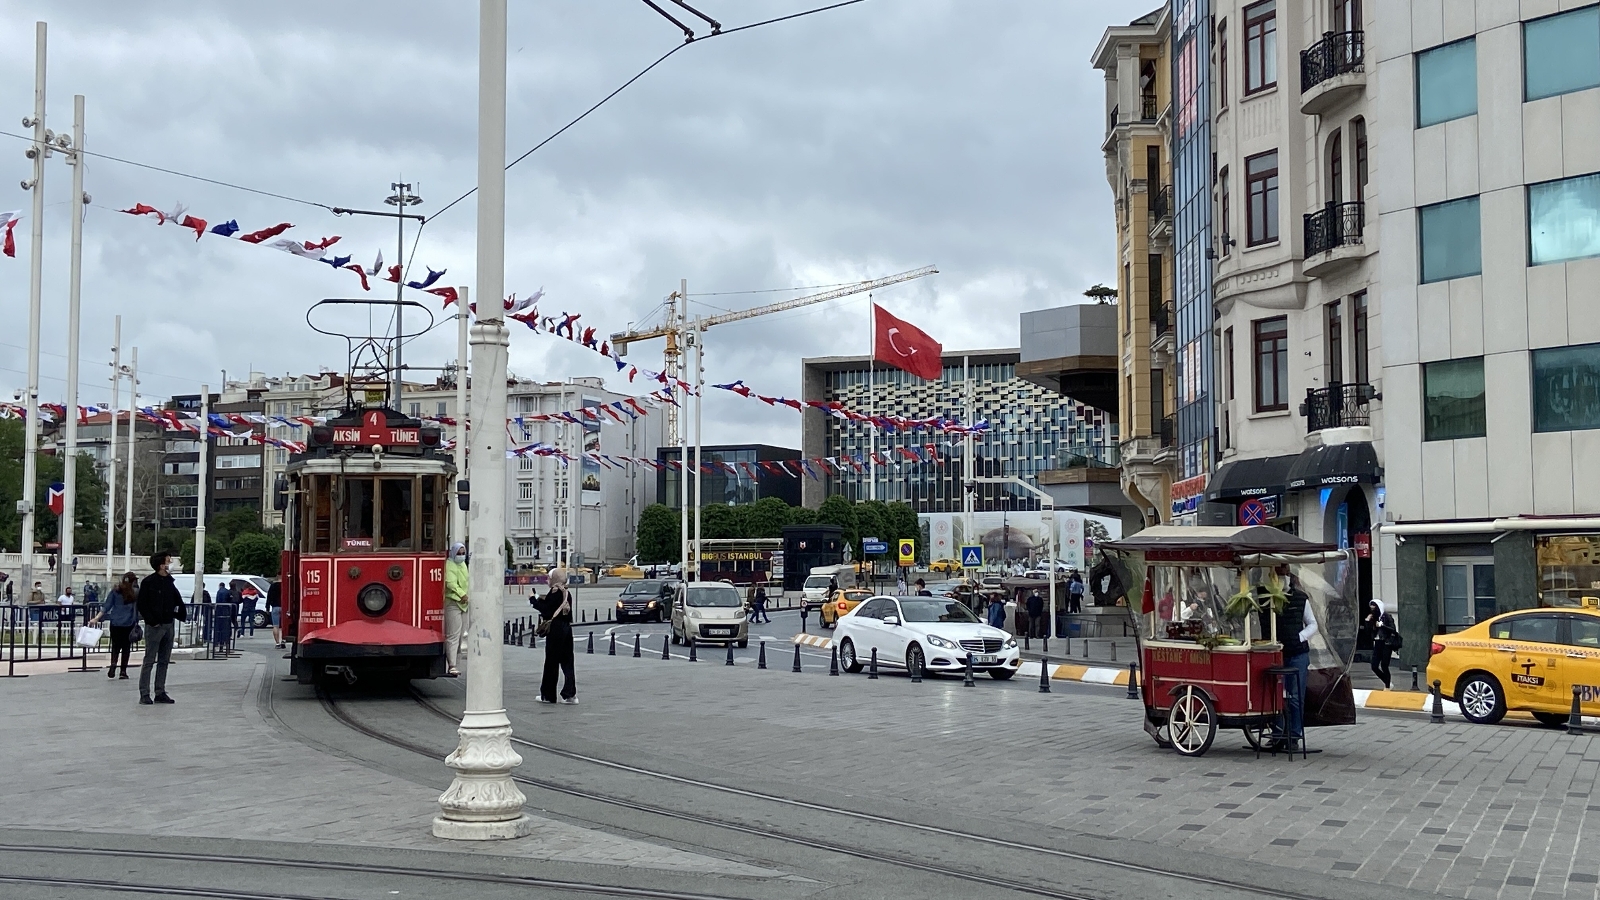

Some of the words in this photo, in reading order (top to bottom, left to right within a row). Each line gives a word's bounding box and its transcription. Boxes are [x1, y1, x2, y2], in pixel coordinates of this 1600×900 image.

[369, 412, 377, 426] 4
[333, 428, 360, 442] AKSİM
[390, 429, 420, 443] TÜNEL
[1320, 475, 1359, 484] watsons
[1240, 487, 1267, 496] watsons
[727, 552, 763, 560] ISTANBUL
[306, 569, 320, 584] 115
[429, 568, 442, 582] 115
[43, 609, 59, 620] POLİS
